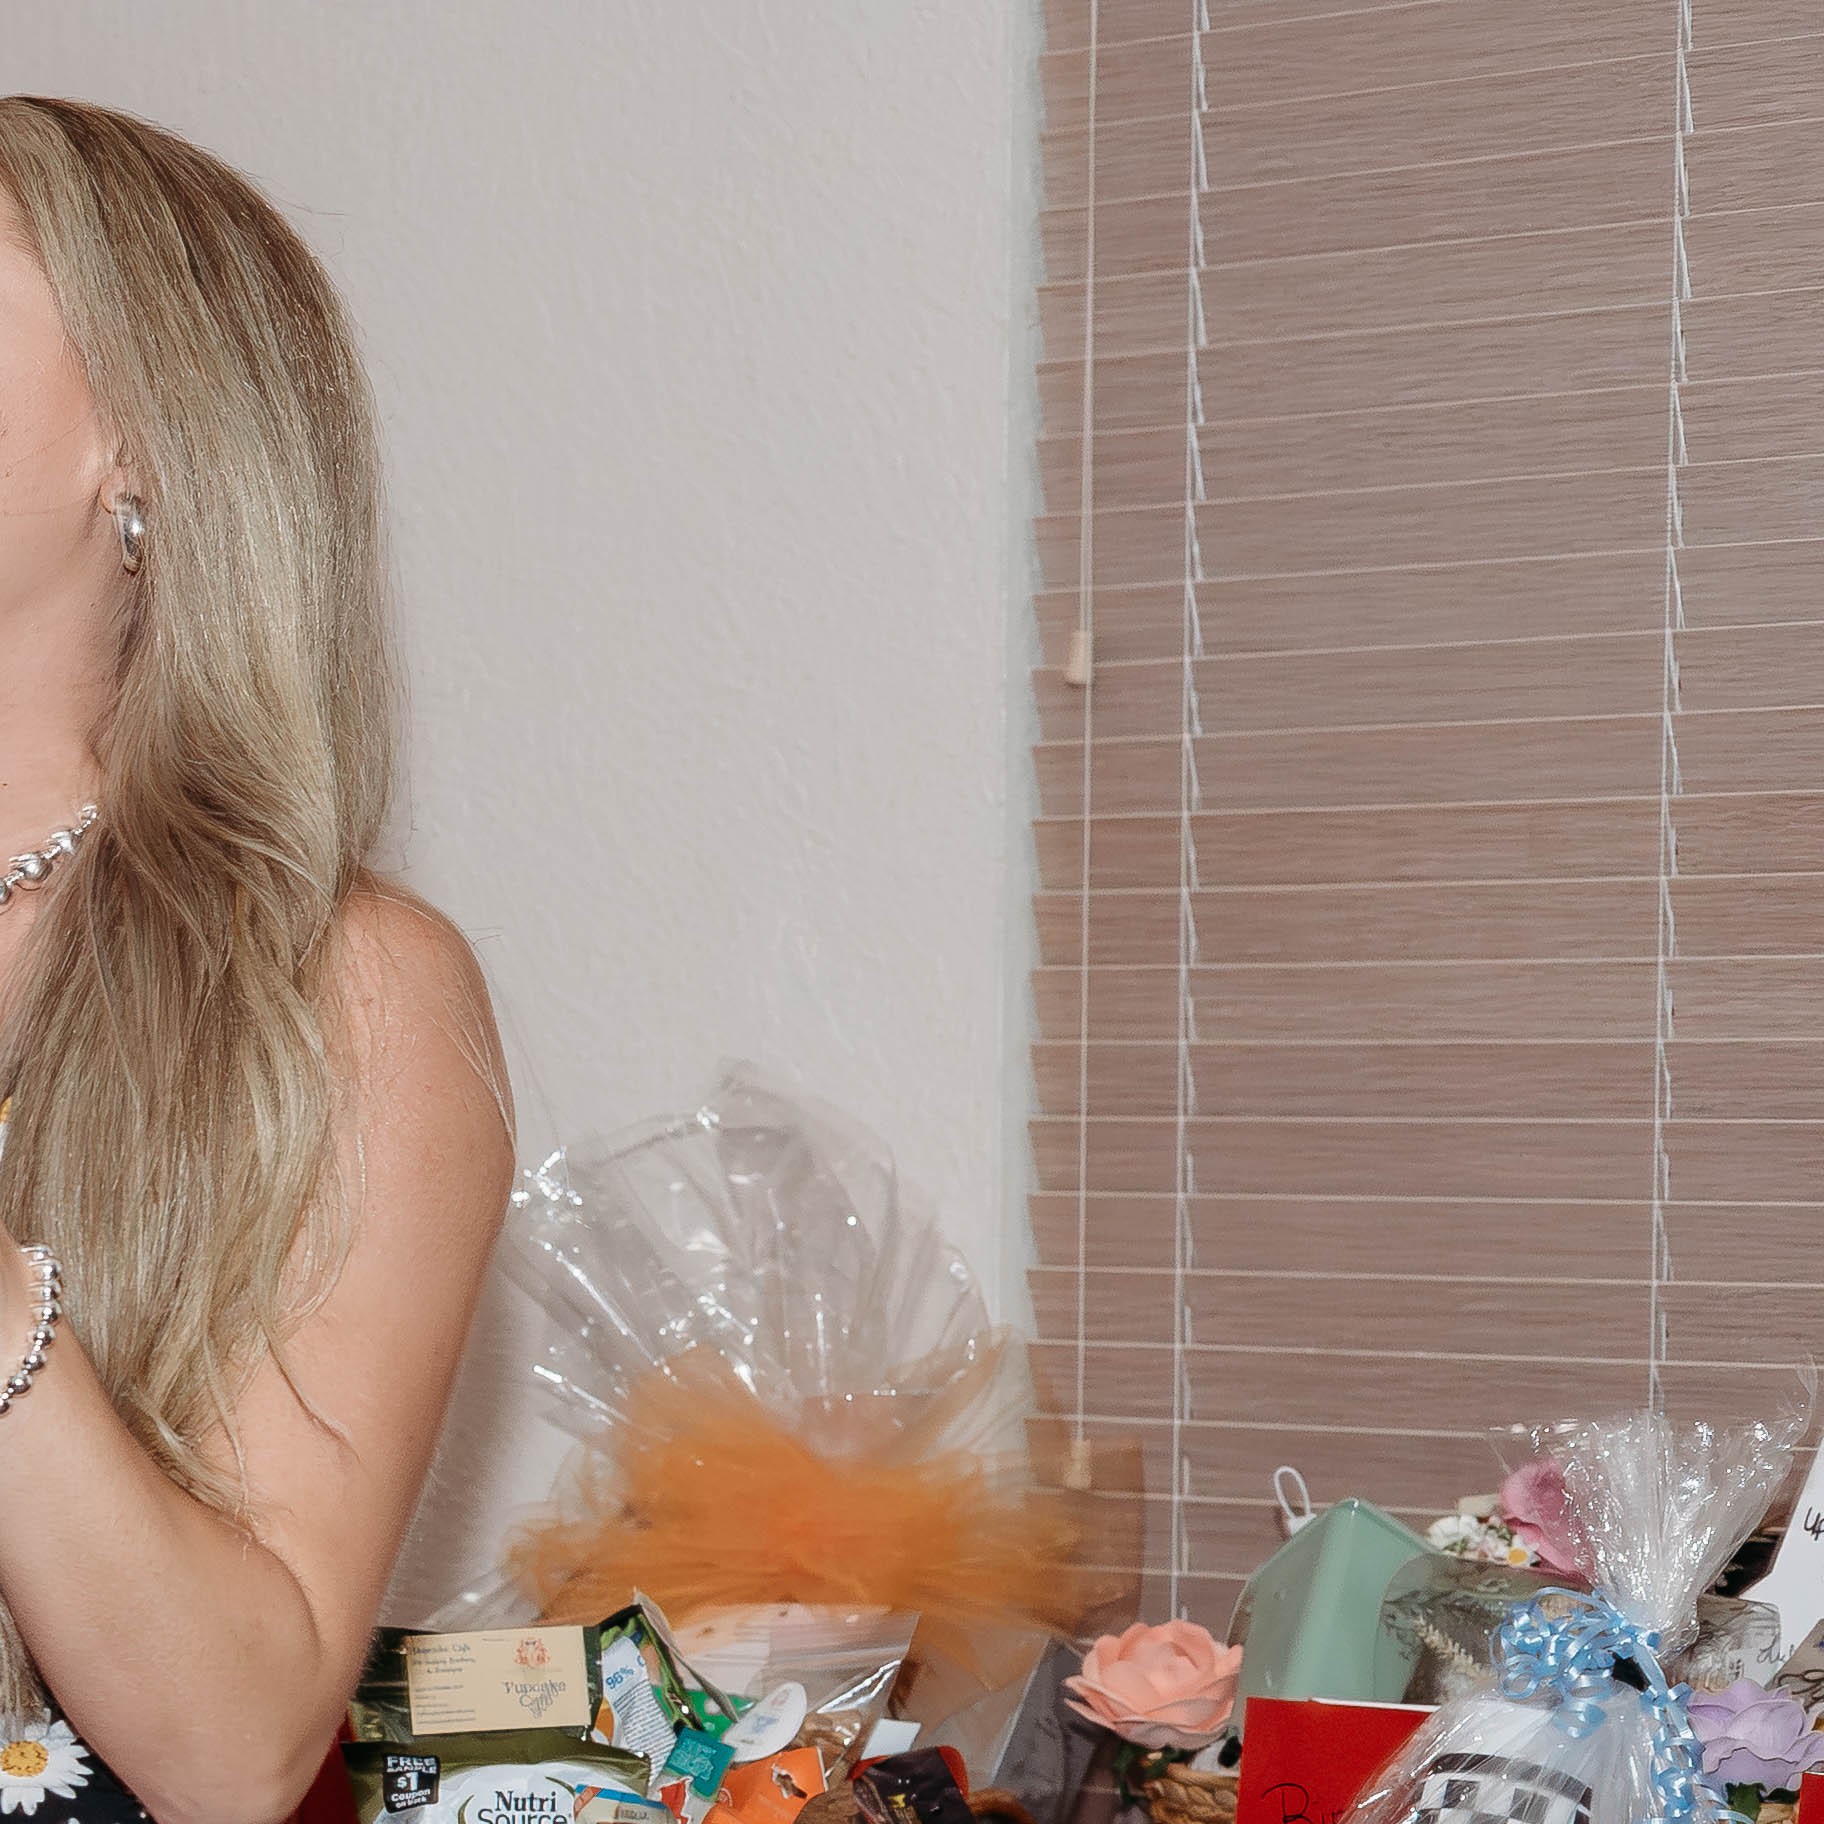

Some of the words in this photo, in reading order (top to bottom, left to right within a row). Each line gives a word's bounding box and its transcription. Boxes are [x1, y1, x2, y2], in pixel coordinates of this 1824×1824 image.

[387, 1756, 437, 1768] FREE
[397, 1771, 419, 1791] $1
[391, 1788, 431, 1802] Coupon
[495, 1791, 557, 1812] Nutri
